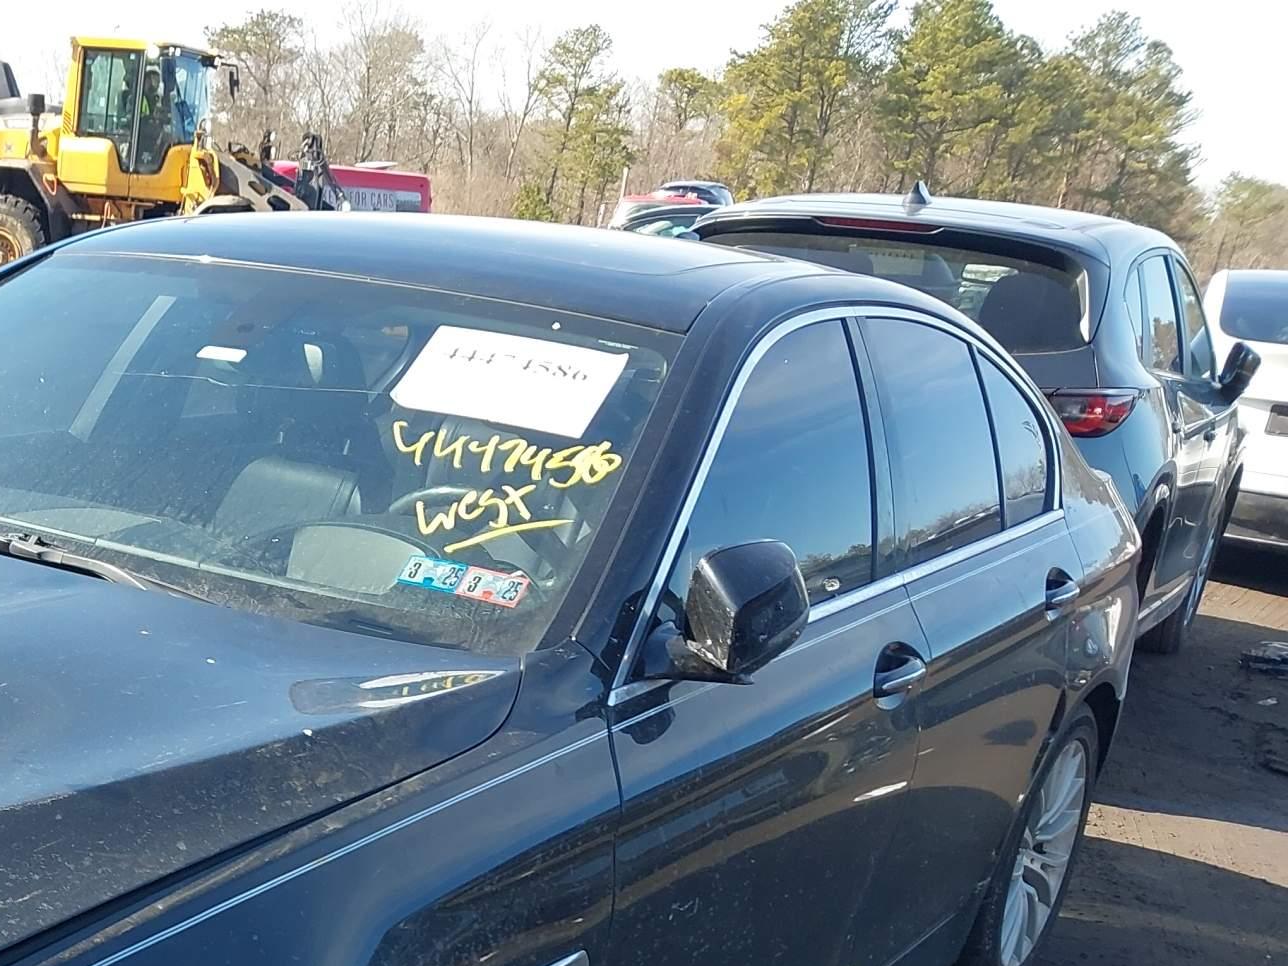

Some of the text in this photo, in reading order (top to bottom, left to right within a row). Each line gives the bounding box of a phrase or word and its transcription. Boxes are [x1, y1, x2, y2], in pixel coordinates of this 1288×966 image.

[370, 191, 394, 209] CARS
[408, 562, 464, 587] 3 25
[467, 575, 523, 602] 3 25
